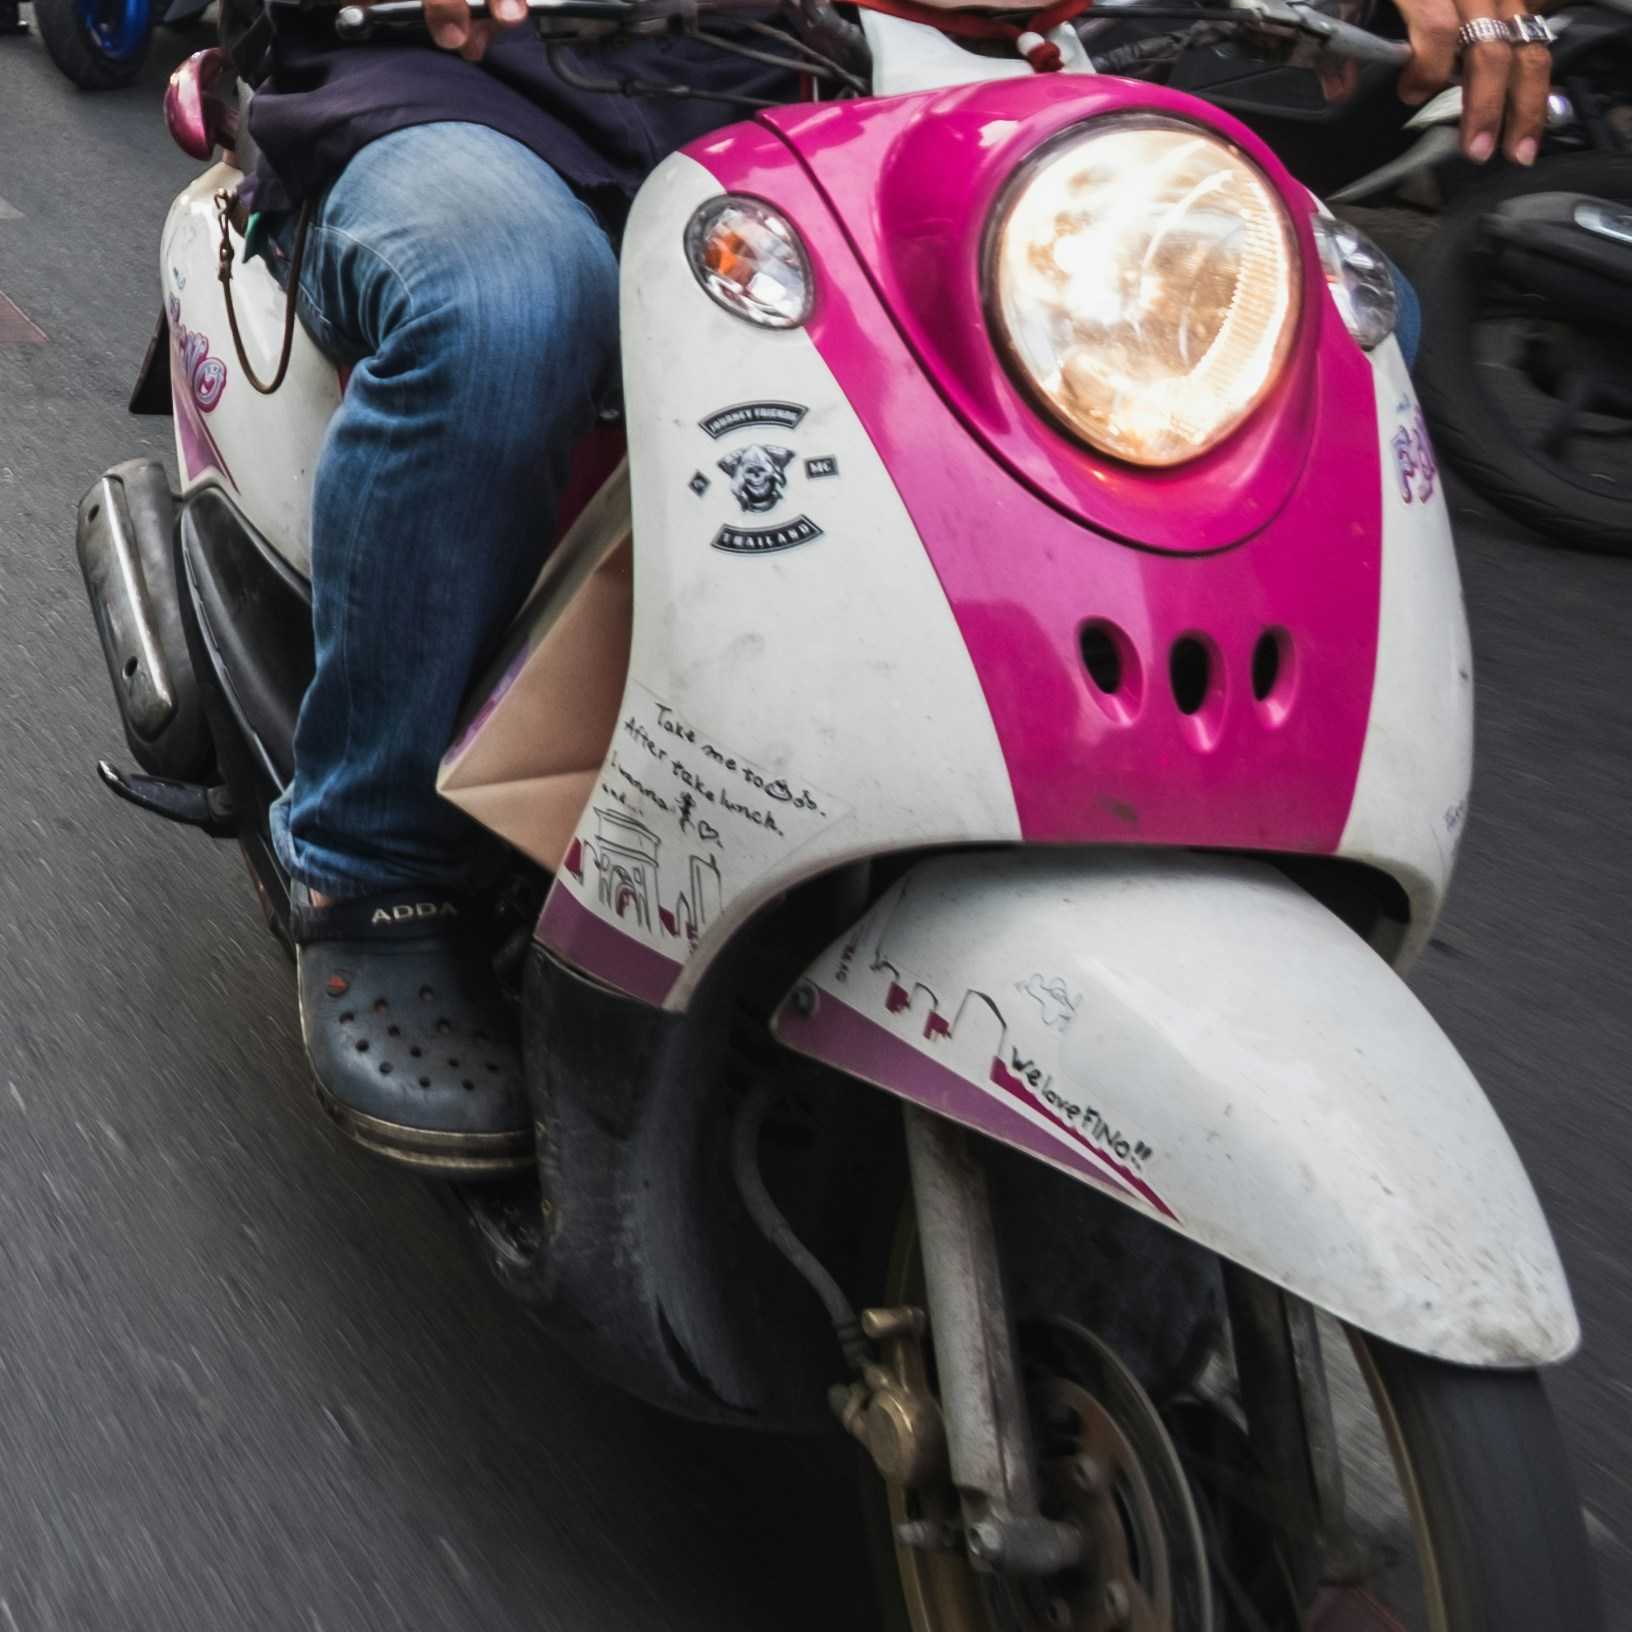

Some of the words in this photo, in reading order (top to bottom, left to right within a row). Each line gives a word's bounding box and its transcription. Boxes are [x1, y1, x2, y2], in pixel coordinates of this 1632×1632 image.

[722, 522, 811, 548] THAILAND
[655, 702, 695, 743] Take
[701, 744, 736, 771] me
[742, 768, 763, 787] to
[371, 902, 459, 925] ADDA
[1012, 1046, 1042, 1087] We
[1042, 1075, 1081, 1120] love
